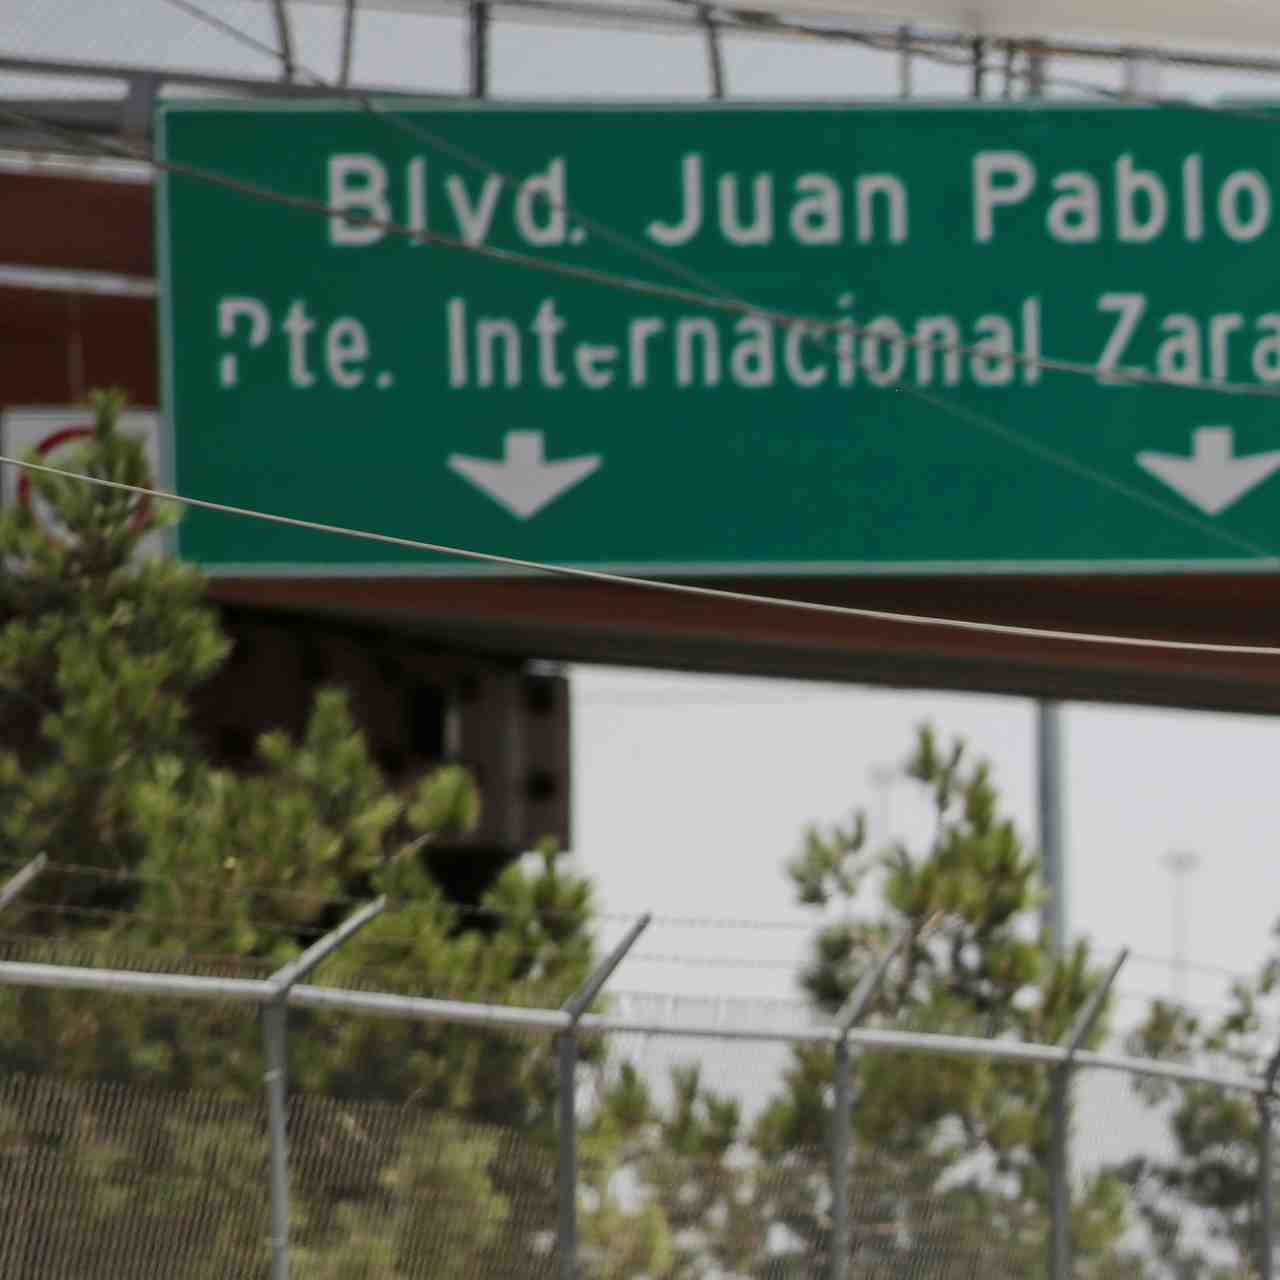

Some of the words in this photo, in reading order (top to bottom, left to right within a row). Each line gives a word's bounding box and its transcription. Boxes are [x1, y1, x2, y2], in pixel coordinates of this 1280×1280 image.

[326, 154, 587, 247] Blvd.
[645, 151, 908, 246] Juan
[972, 149, 1272, 243] Pablo
[217, 297, 393, 388] Pte.
[447, 293, 1042, 389] Internacional
